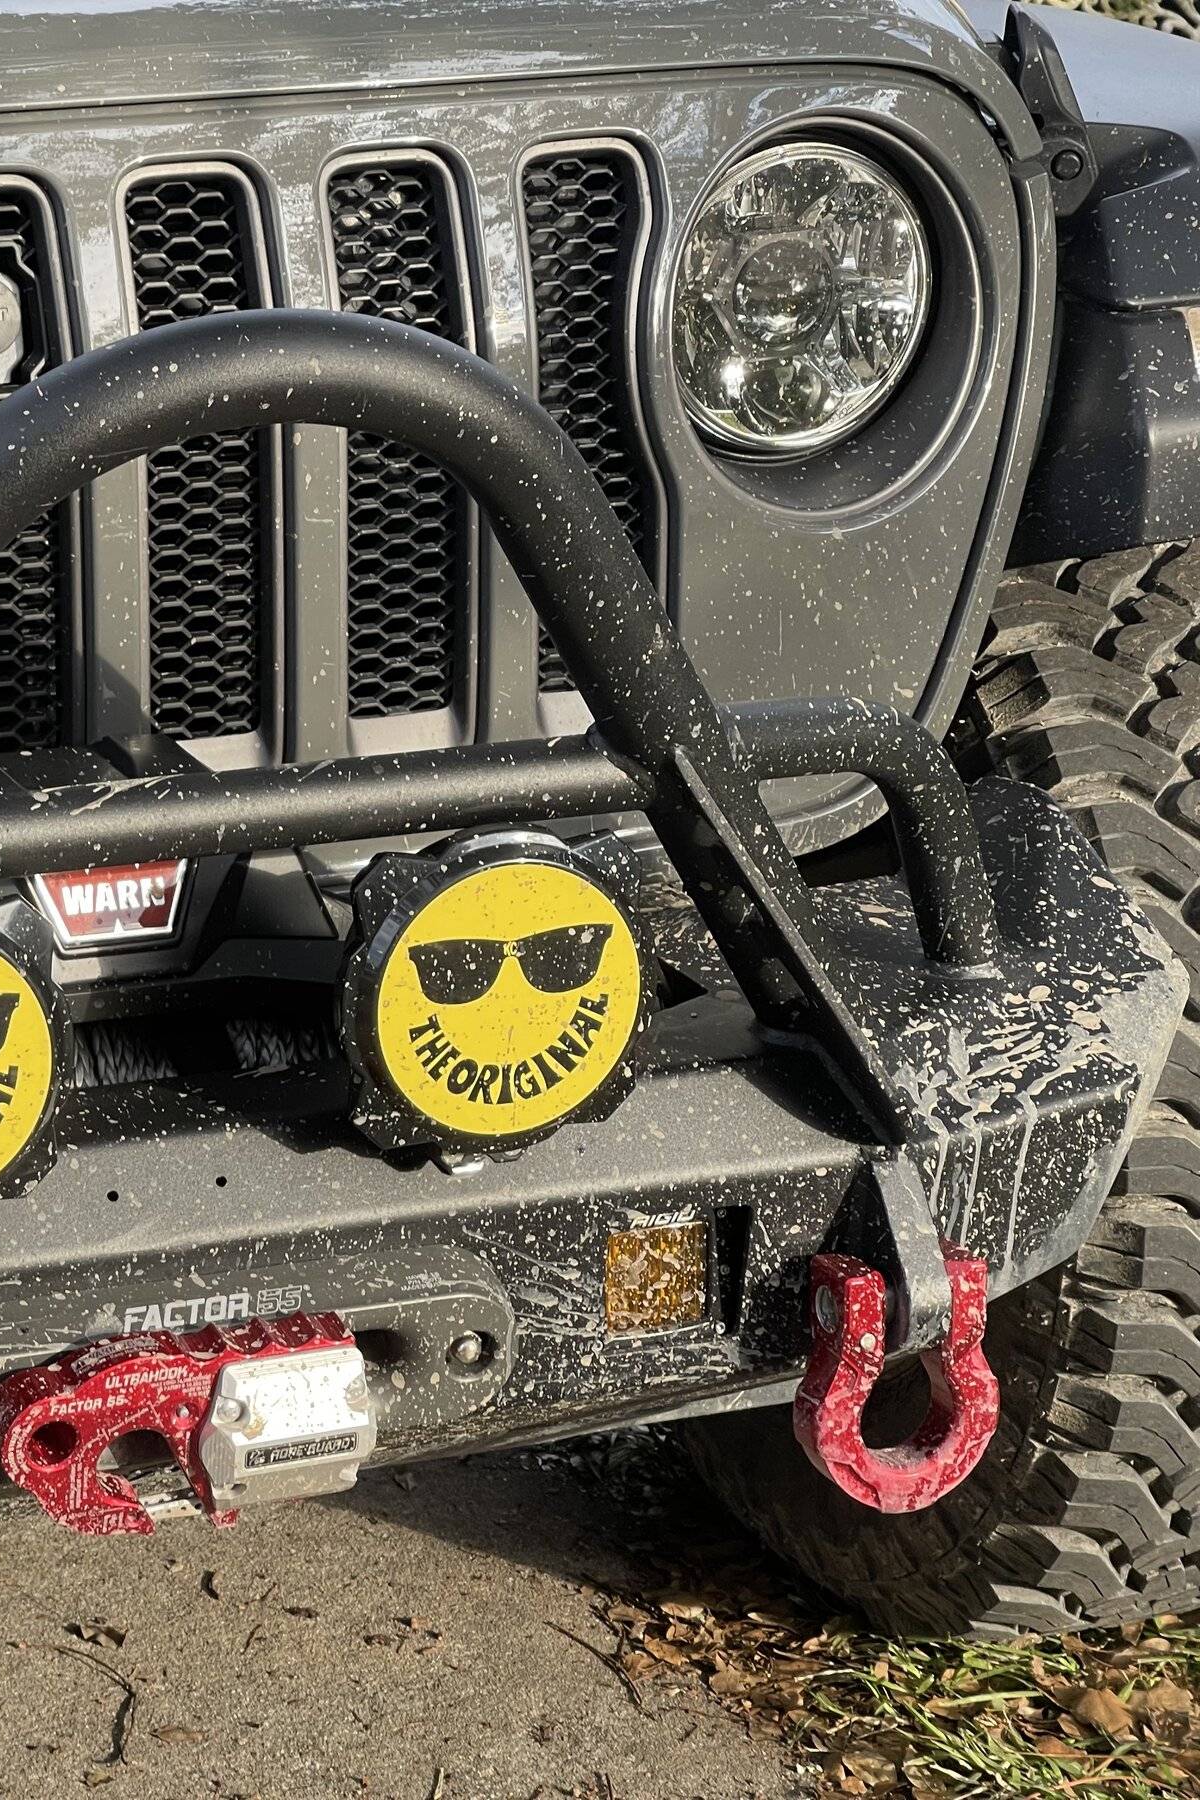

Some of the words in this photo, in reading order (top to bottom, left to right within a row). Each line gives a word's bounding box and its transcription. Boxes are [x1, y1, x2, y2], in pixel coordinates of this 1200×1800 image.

[61, 876, 166, 916] WARN
[503, 941, 517, 957] KC
[447, 993, 609, 1105] ORIGINAL
[123, 1292, 251, 1333] FACTOR
[256, 1285, 303, 1315] 55
[105, 1365, 188, 1390] ULTRAHOOK
[50, 1397, 103, 1416] FACTOR
